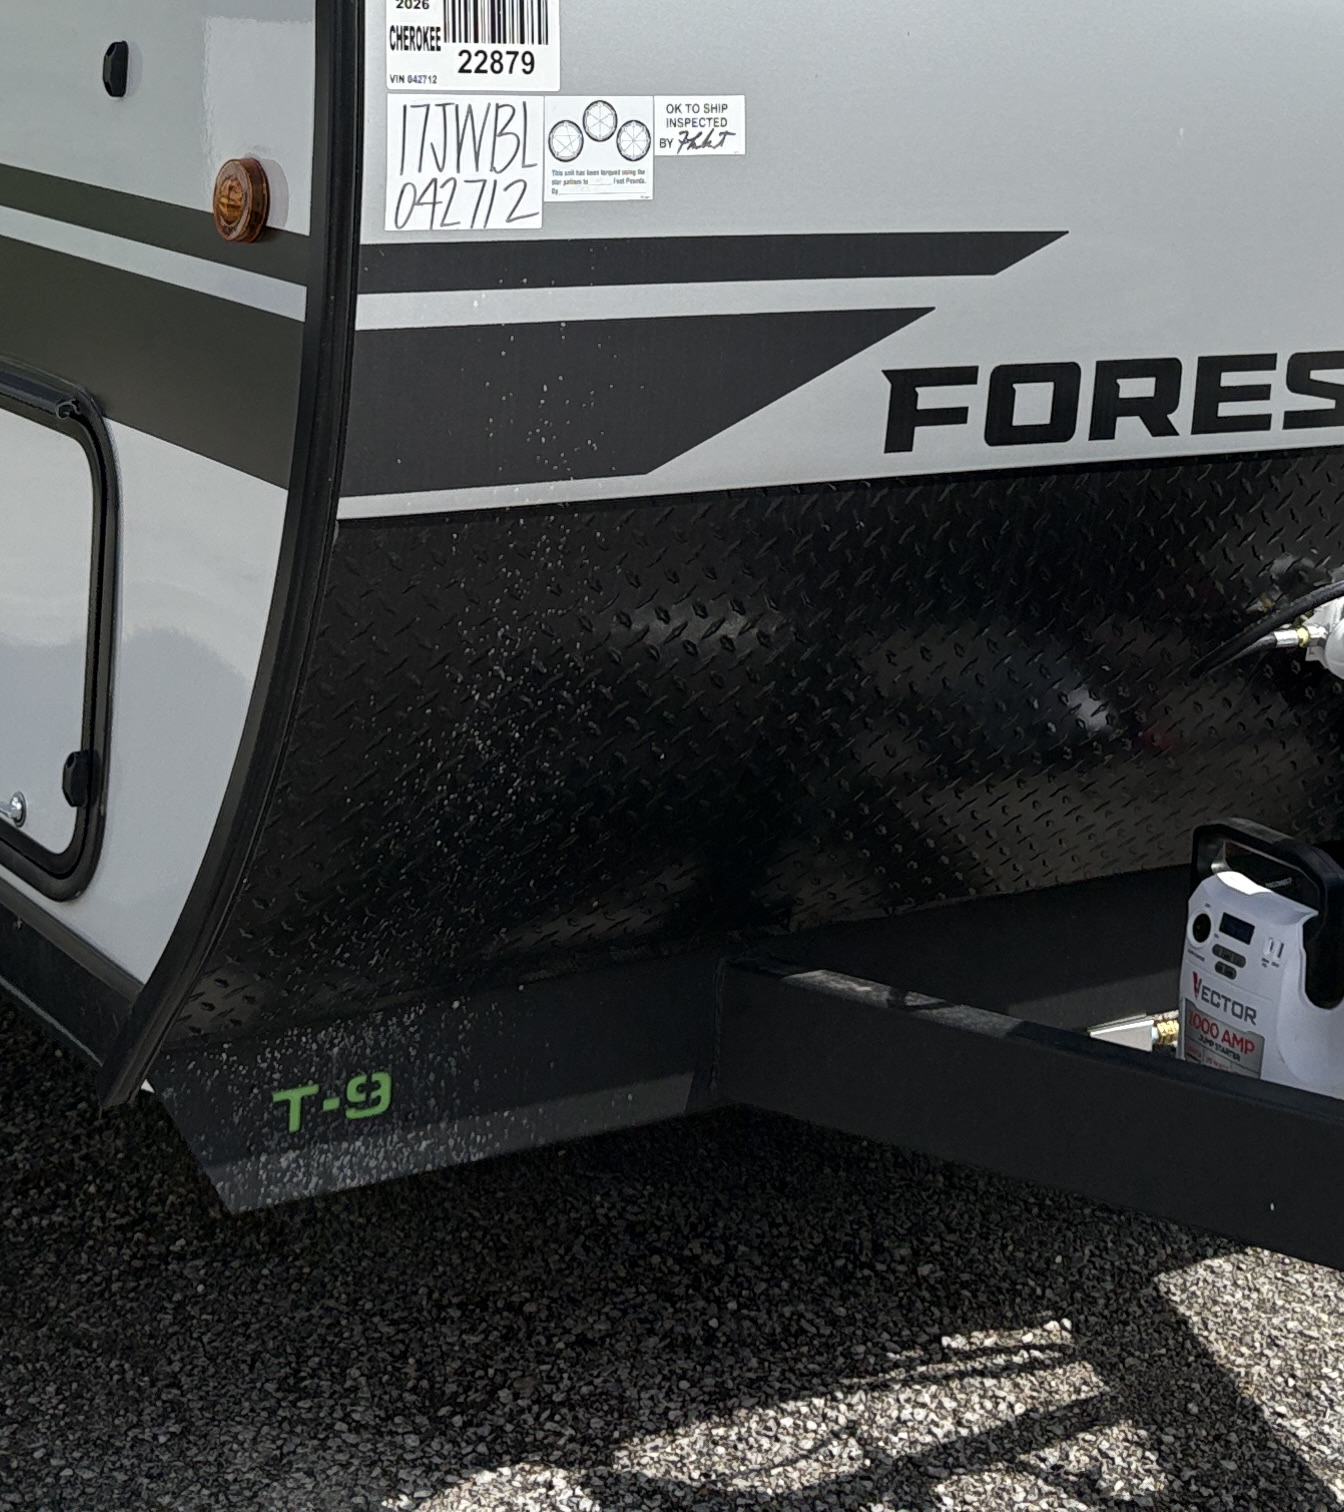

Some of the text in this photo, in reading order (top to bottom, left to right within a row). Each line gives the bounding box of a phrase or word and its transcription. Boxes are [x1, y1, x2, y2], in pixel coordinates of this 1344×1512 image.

[389, 24, 442, 52] CHEROKEE
[457, 49, 536, 75] 22879
[389, 74, 438, 85] VIN 042712
[665, 103, 729, 114] OK TO SHIP
[665, 117, 728, 128] INSPECTED
[399, 100, 538, 176] 17JWBL
[659, 137, 675, 149] BY
[394, 176, 540, 230] 042712
[1192, 971, 1258, 1026] VECTOR
[1188, 1010, 1256, 1055] 1000 AMP
[272, 1070, 393, 1134] T-9
